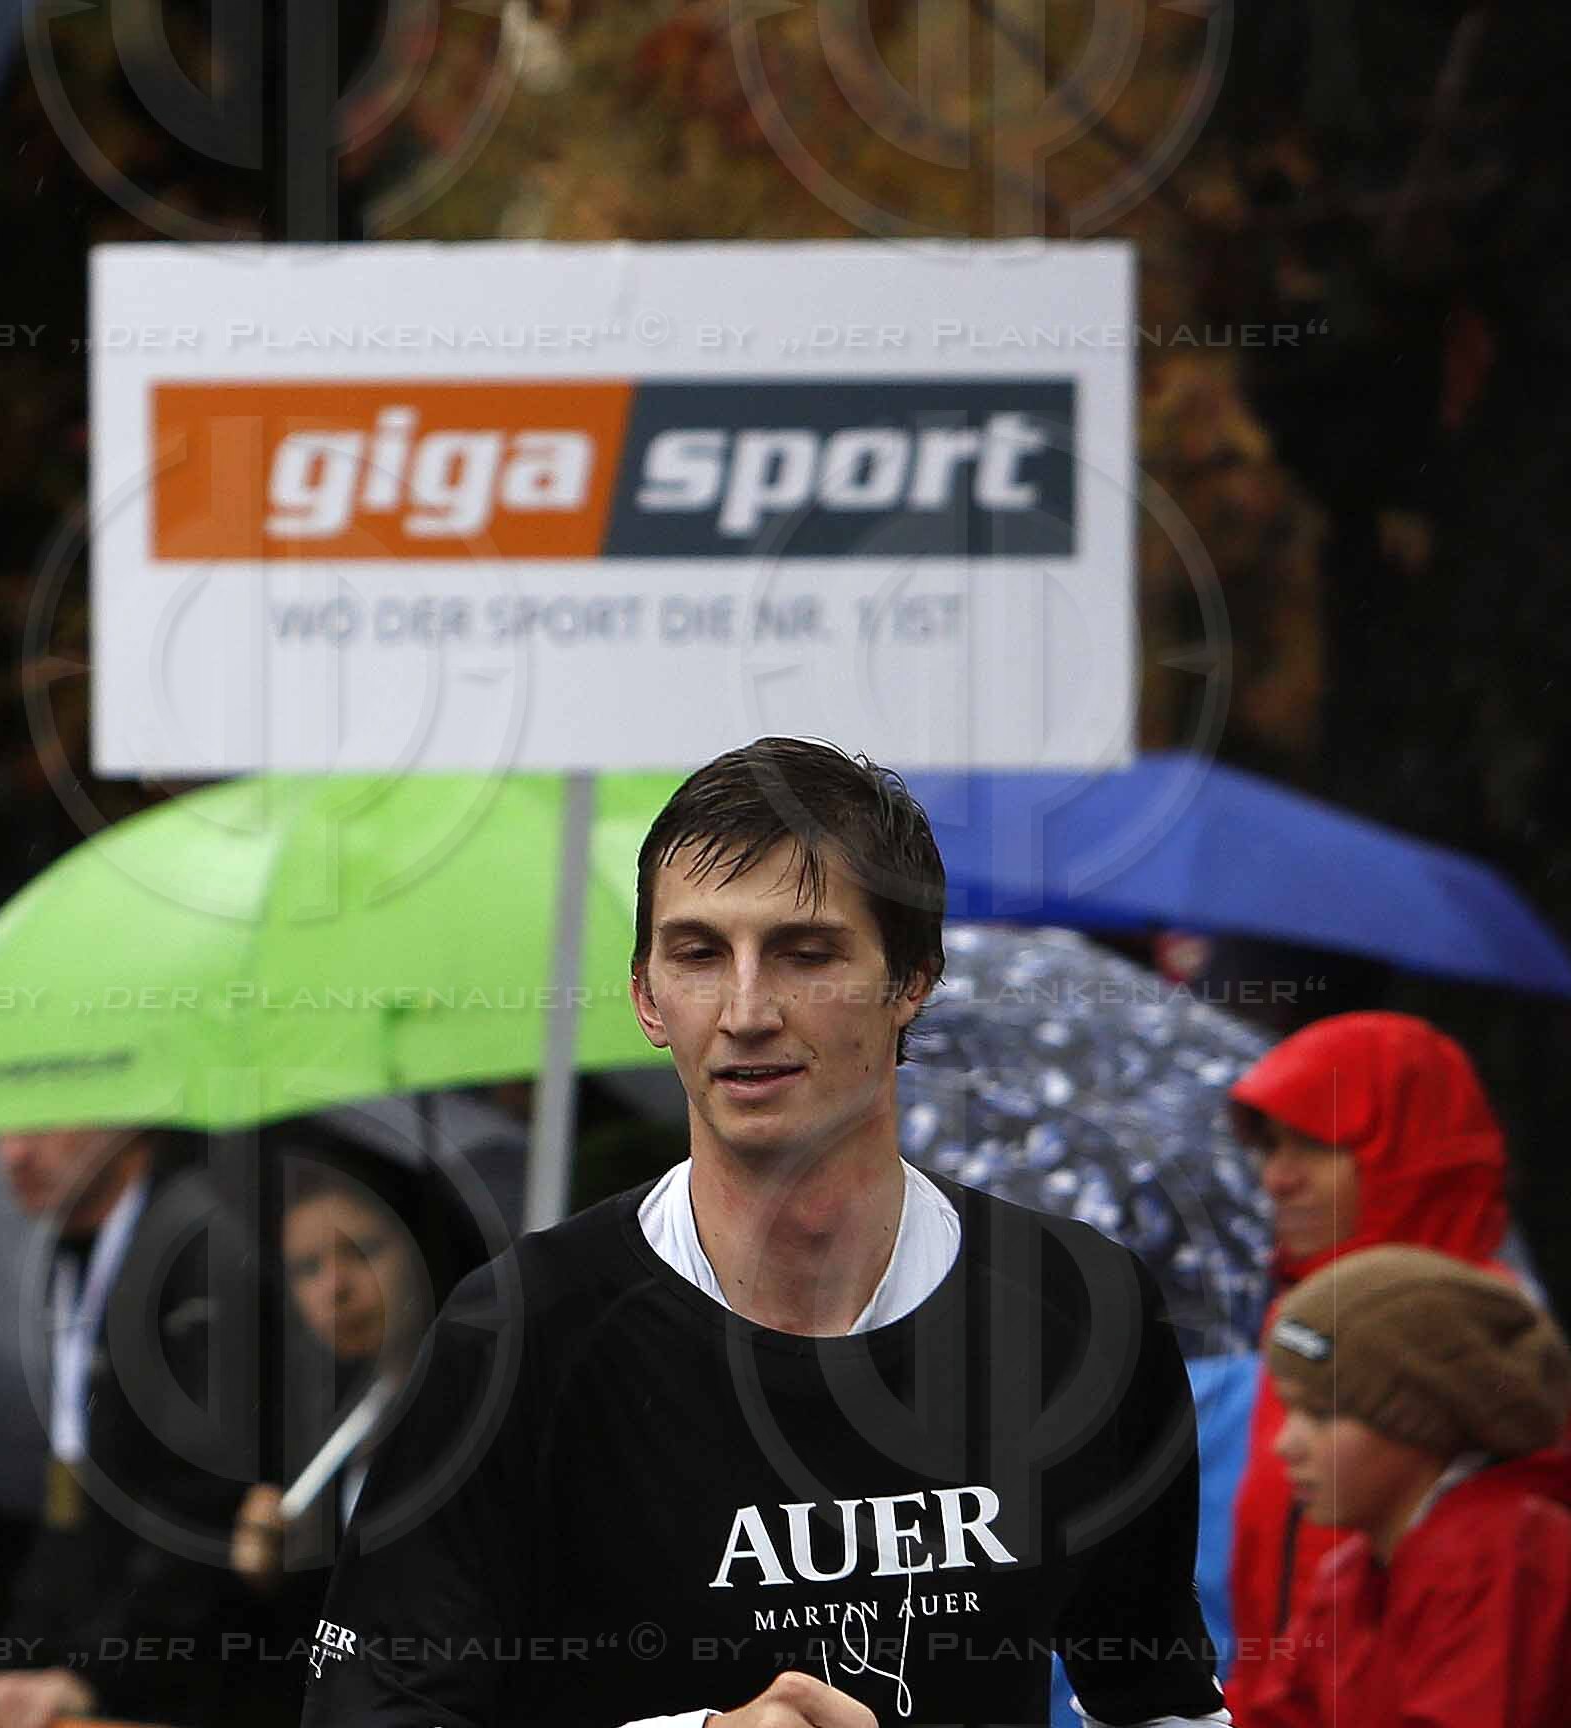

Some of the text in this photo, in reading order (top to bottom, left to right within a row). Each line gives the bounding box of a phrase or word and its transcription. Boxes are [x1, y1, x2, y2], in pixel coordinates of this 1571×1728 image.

[264, 405, 1046, 539] giga sport
[483, 595, 645, 645] SPORT
[709, 1486, 1018, 1588] AUER
[754, 1591, 981, 1631] MARTIN AUER
